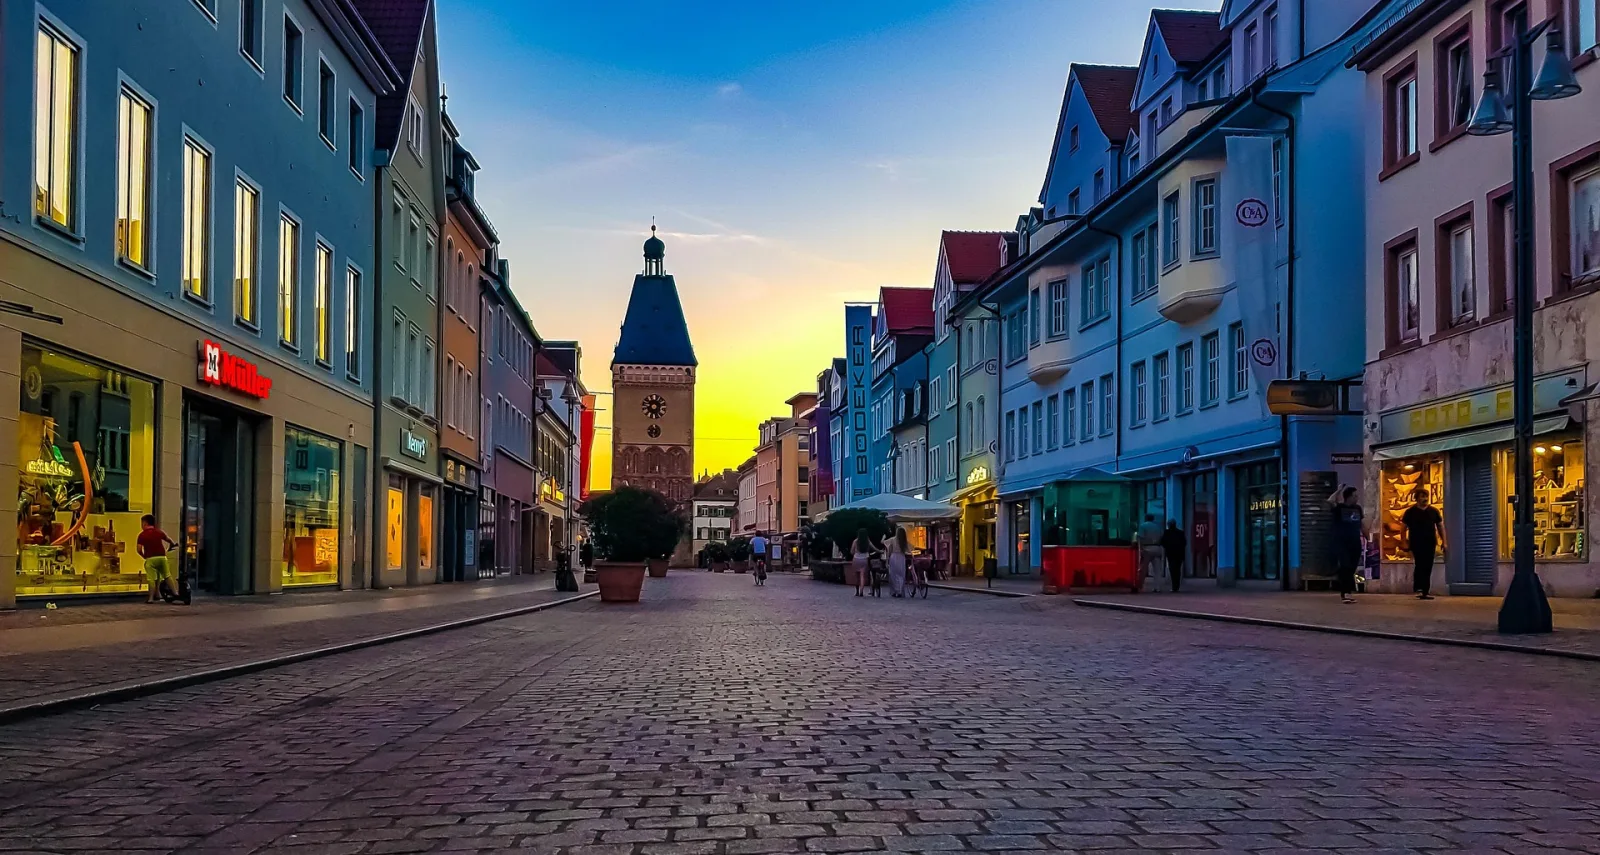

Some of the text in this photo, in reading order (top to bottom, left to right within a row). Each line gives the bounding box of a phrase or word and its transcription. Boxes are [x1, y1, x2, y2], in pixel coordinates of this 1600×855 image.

[1242, 206, 1263, 219] C&A
[1256, 346, 1273, 360] C&A
[222, 350, 273, 400] Müller
[852, 325, 868, 475] BÖDEKER
